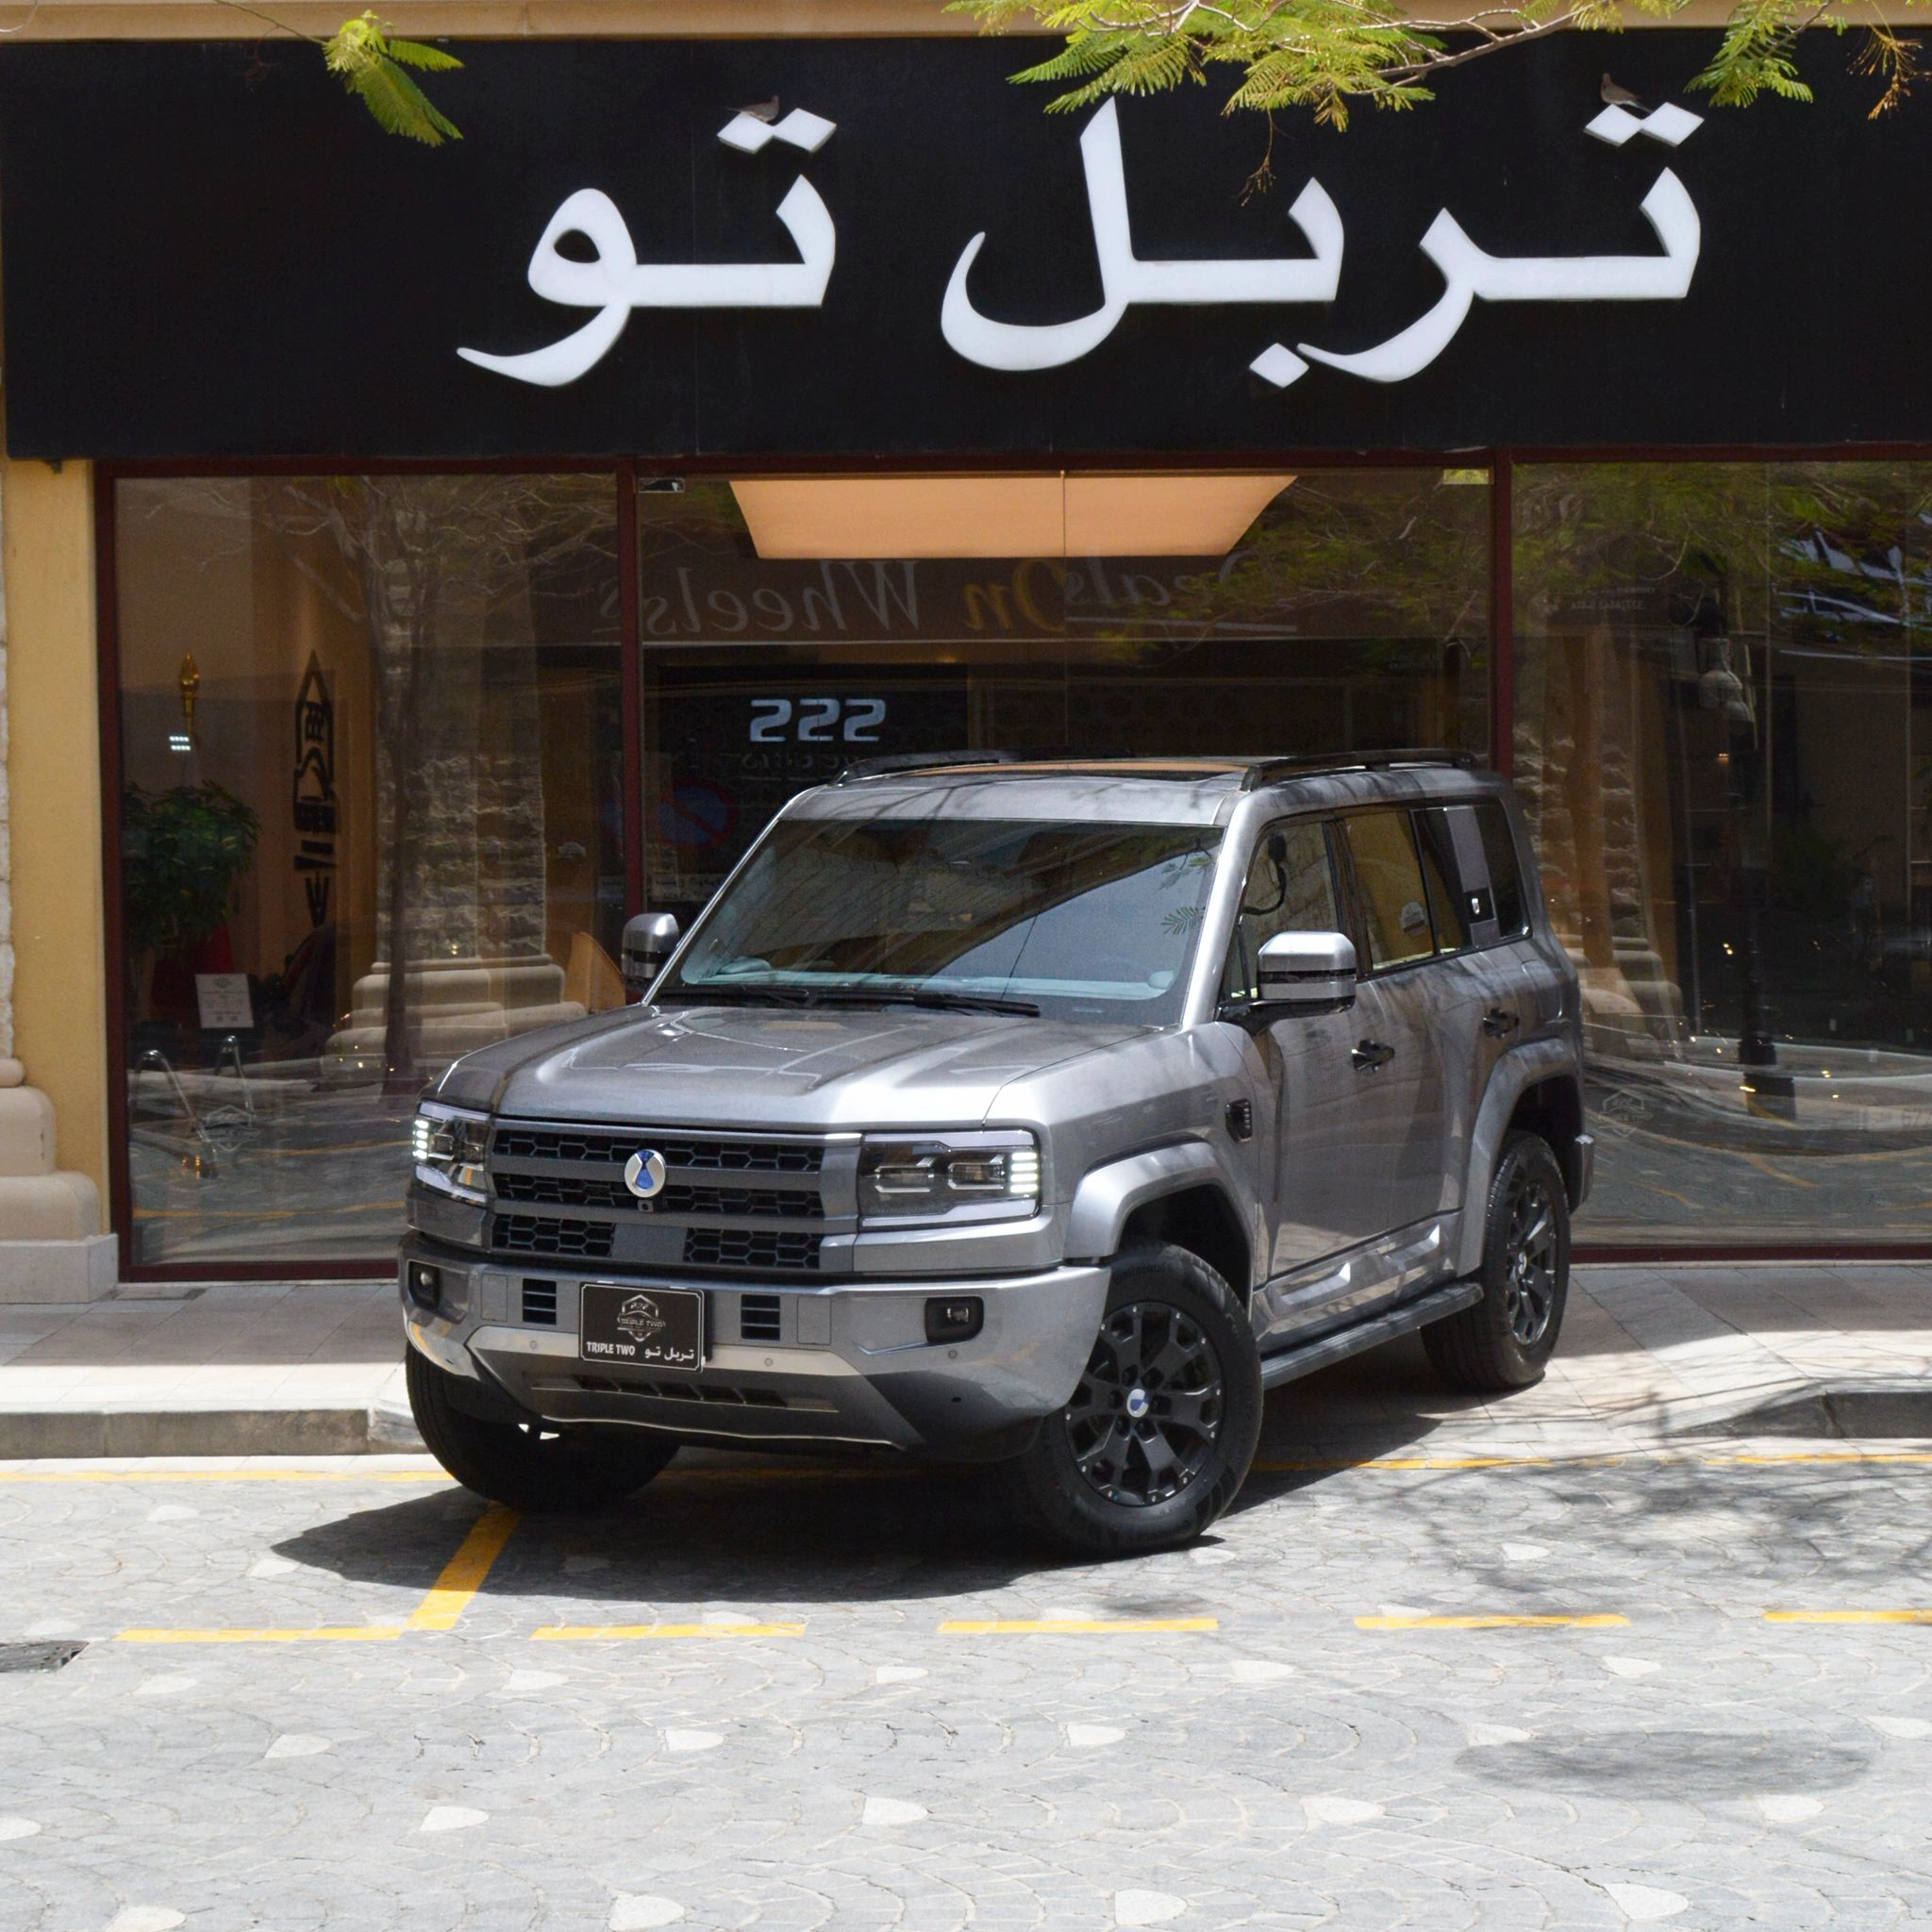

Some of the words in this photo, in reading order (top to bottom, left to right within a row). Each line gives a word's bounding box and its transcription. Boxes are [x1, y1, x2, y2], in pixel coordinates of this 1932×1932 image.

[457, 108, 837, 387] تو
[941, 97, 1705, 388] تربل
[586, 1341, 614, 1355] TRIPLE
[615, 1343, 636, 1357] TWO
[644, 1345, 661, 1359] تو
